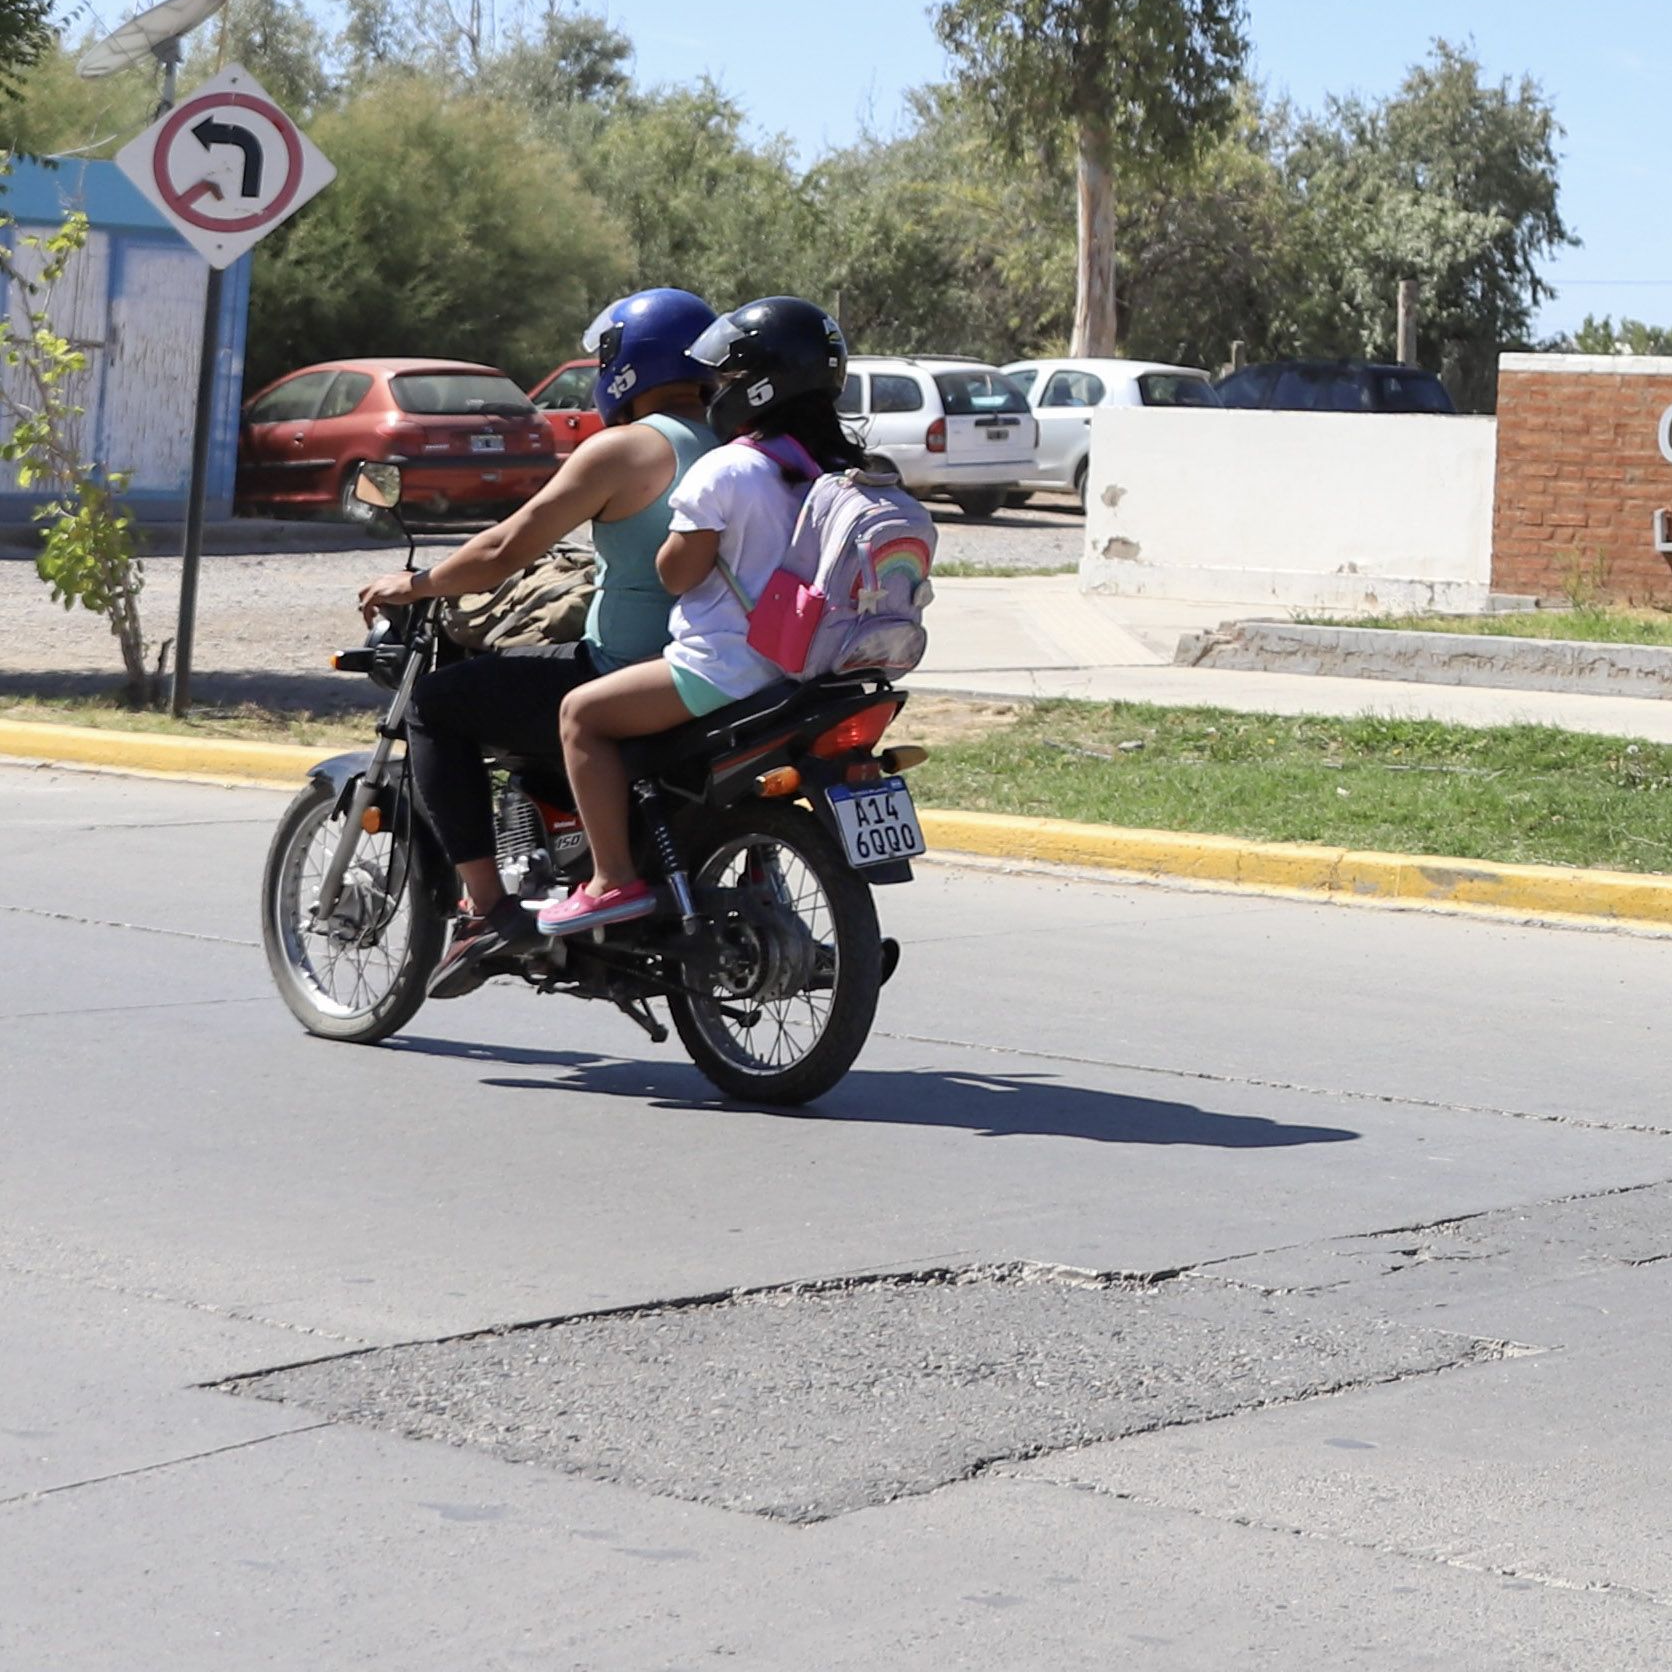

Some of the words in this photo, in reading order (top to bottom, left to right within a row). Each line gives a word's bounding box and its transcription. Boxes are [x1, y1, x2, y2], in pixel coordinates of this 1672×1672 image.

[747, 377, 775, 407] 5
[854, 795, 899, 827] A14
[557, 834, 581, 848] 150
